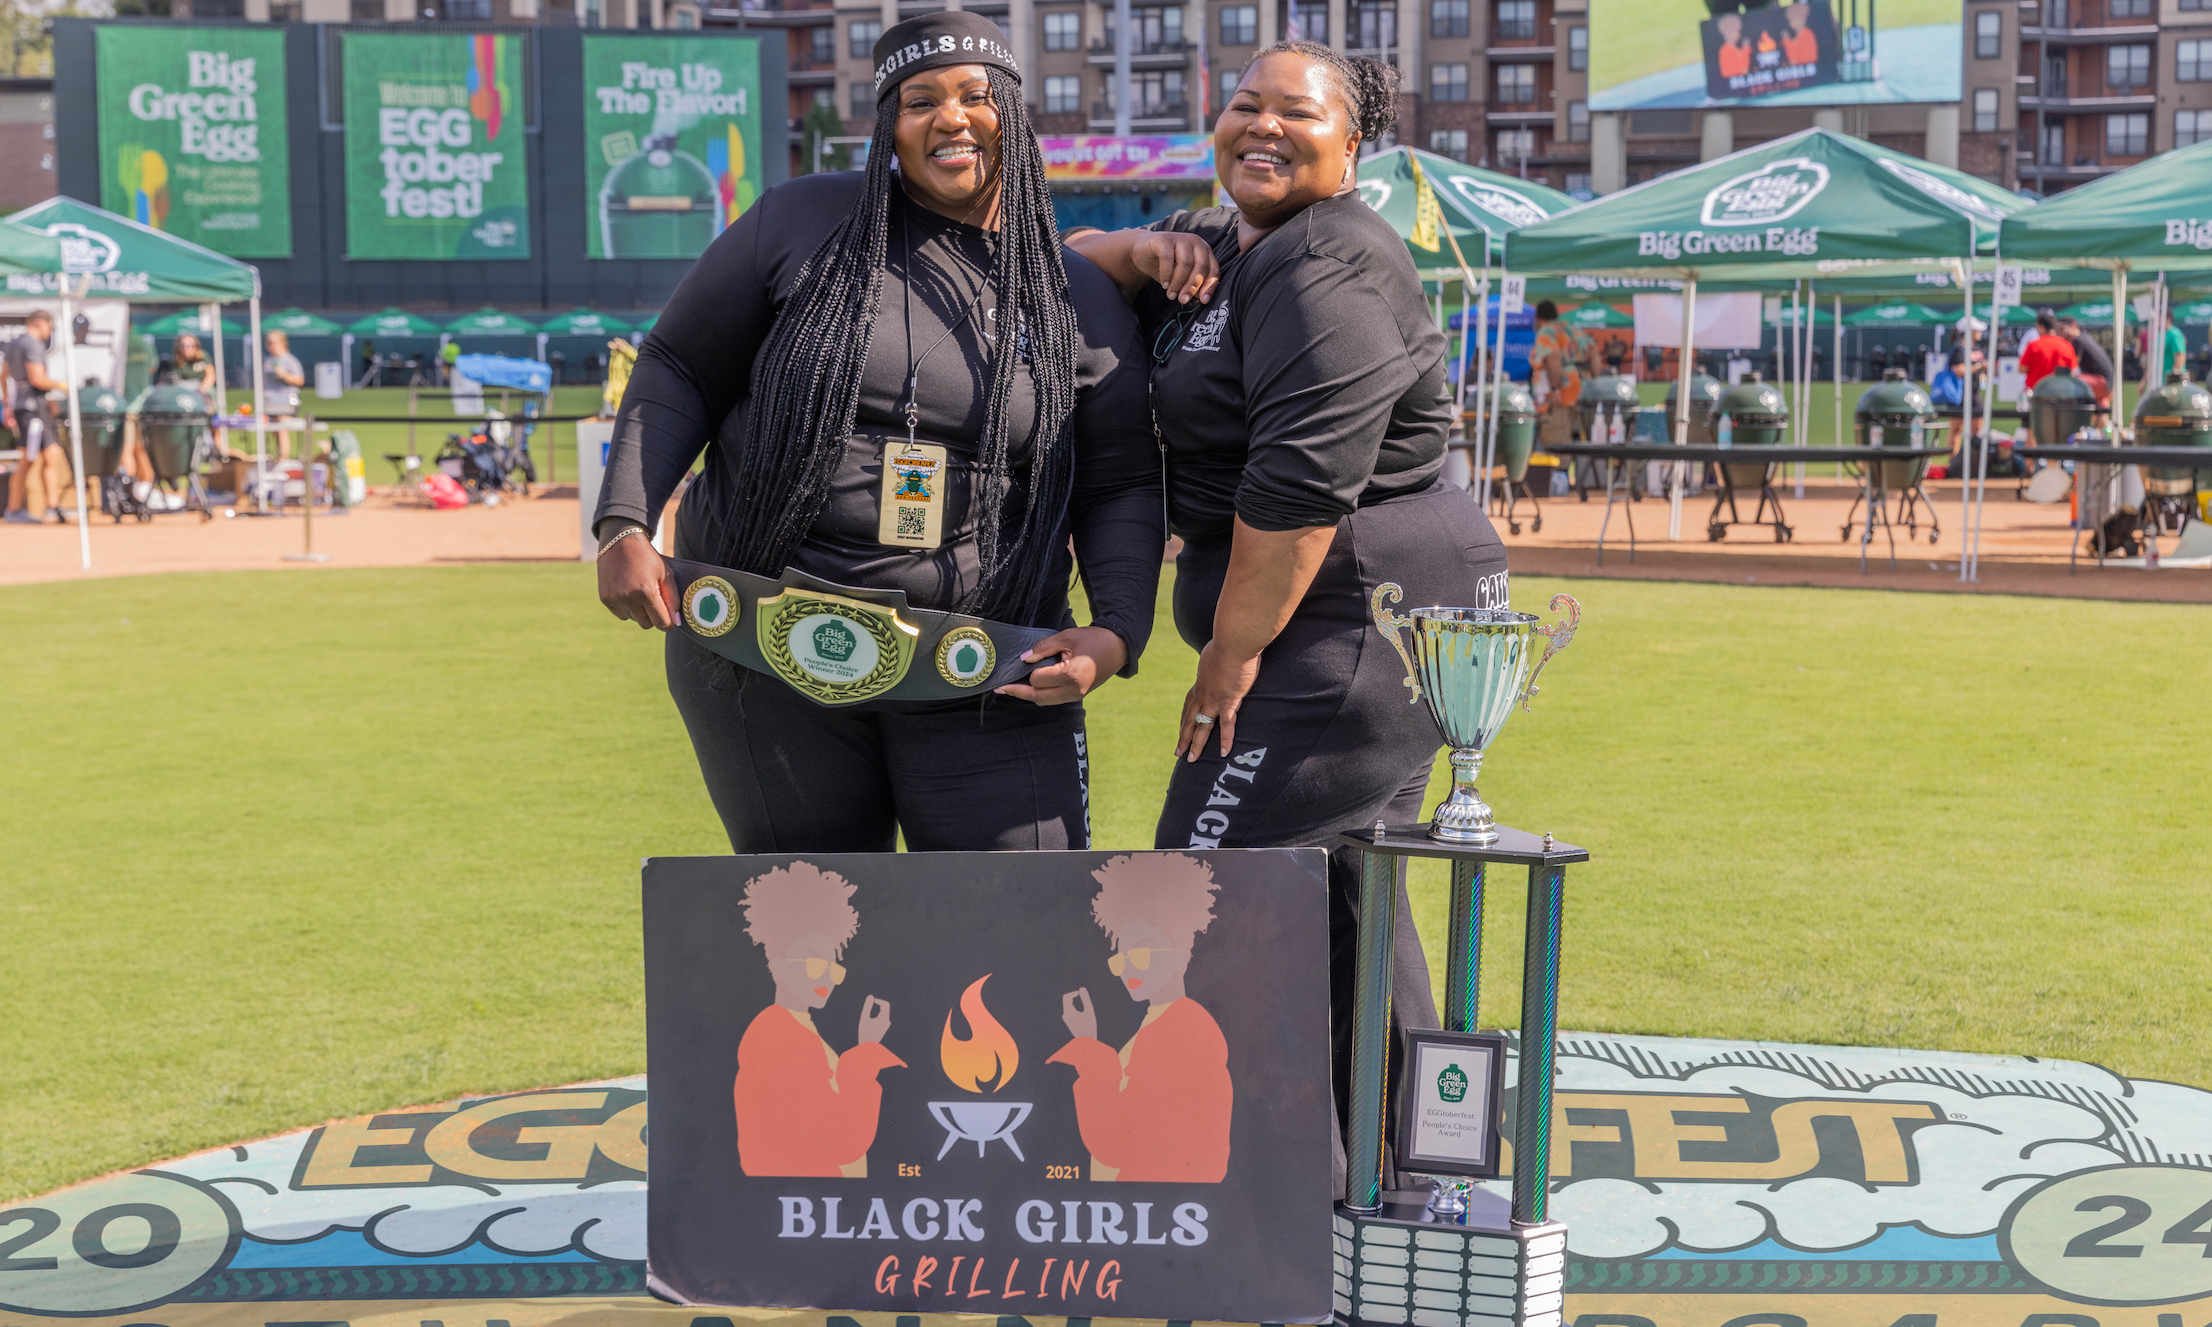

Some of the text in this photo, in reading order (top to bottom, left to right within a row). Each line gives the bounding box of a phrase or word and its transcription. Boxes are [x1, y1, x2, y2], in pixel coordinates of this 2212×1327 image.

[886, 34, 956, 74] GIRLS
[187, 50, 257, 94] Big
[621, 61, 722, 90] Fire Up
[1729, 68, 1774, 90] BLACK
[128, 82, 258, 121] Green
[597, 86, 747, 116] The Flavor!
[379, 107, 472, 147] EGG
[180, 118, 260, 162] Egg
[1095, 144, 1123, 163] GOT
[379, 147, 503, 182] tober
[380, 180, 483, 218] fest!
[1638, 226, 1821, 260] Big Green Egg
[2164, 217, 2212, 251] Big
[2001, 270, 2018, 288] 45
[815, 633, 853, 648] Green
[825, 627, 846, 640] Big
[821, 642, 846, 655] Egg
[804, 657, 859, 673] People's Choice
[807, 664, 854, 678] Winner 2024
[1438, 1078, 1466, 1088] Green
[1446, 1072, 1461, 1081] Big
[1443, 1086, 1461, 1096] Egg
[1426, 1108, 1475, 1120] EGGtoberfest
[1422, 1120, 1478, 1132] People's Choice
[1437, 1129, 1461, 1138] Award
[898, 1163, 1080, 1179] Est 2021
[778, 1196, 1210, 1247] BLACK GIRLS
[873, 1254, 1125, 1303] GRILLING
